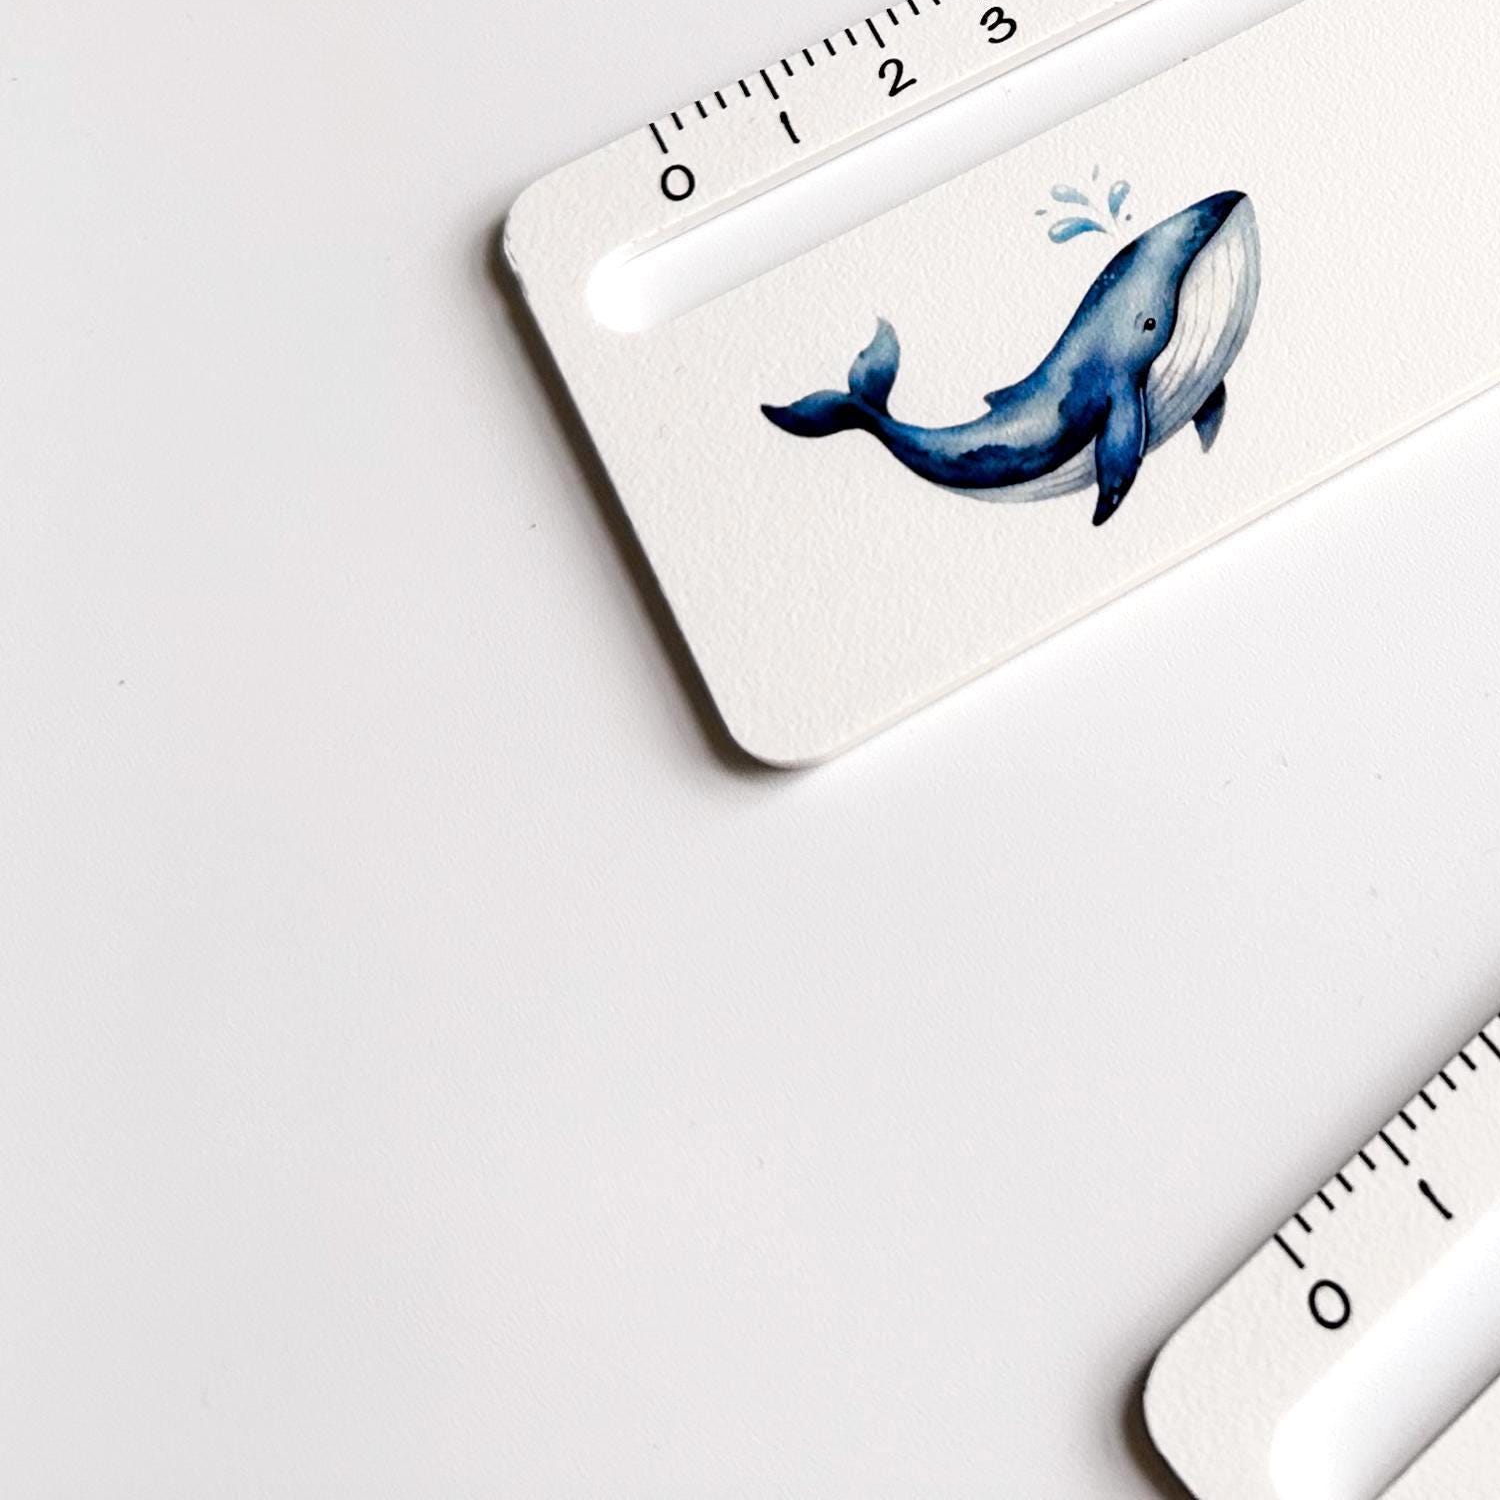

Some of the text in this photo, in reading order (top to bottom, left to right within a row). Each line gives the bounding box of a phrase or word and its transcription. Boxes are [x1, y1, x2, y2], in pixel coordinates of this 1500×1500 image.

[660, 164, 695, 201] 0
[779, 111, 800, 144] 1
[878, 58, 917, 97] 2
[980, 7, 1017, 44] 3
[1308, 1279, 1352, 1330] 0
[1418, 1179, 1453, 1220] 1
